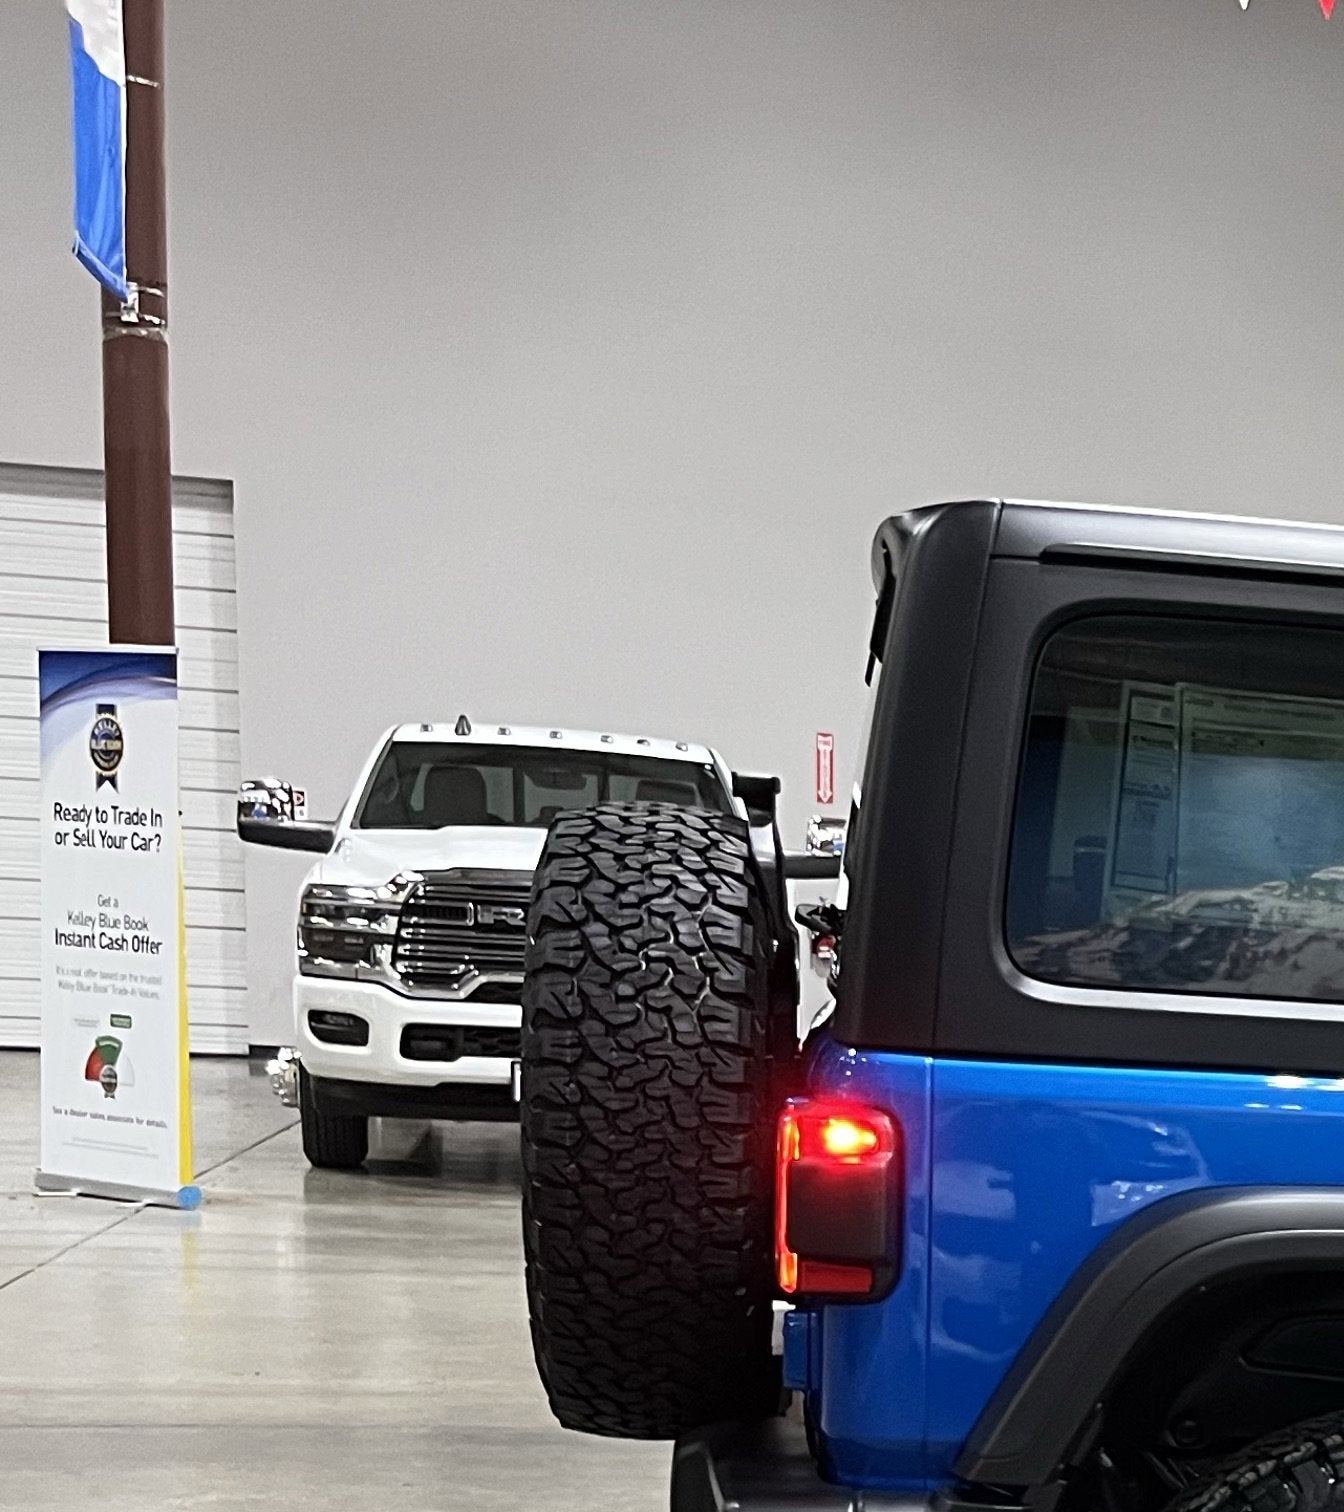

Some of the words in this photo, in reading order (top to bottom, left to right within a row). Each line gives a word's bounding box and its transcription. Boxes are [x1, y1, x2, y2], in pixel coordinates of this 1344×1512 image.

[54, 802, 92, 828] Ready
[95, 806, 108, 824] to
[111, 806, 147, 827] Trade
[150, 808, 163, 828] In
[55, 831, 70, 846] or
[73, 828, 96, 848] Sell
[99, 830, 128, 850] Your
[131, 832, 162, 853] Car?
[97, 894, 111, 908] Get
[113, 898, 119, 908] a
[67, 909, 96, 932] Kelley
[98, 912, 121, 929] Blue
[123, 914, 149, 931] Book
[55, 928, 96, 949] Instant
[99, 932, 129, 951] Cash
[131, 934, 162, 954] Offer
